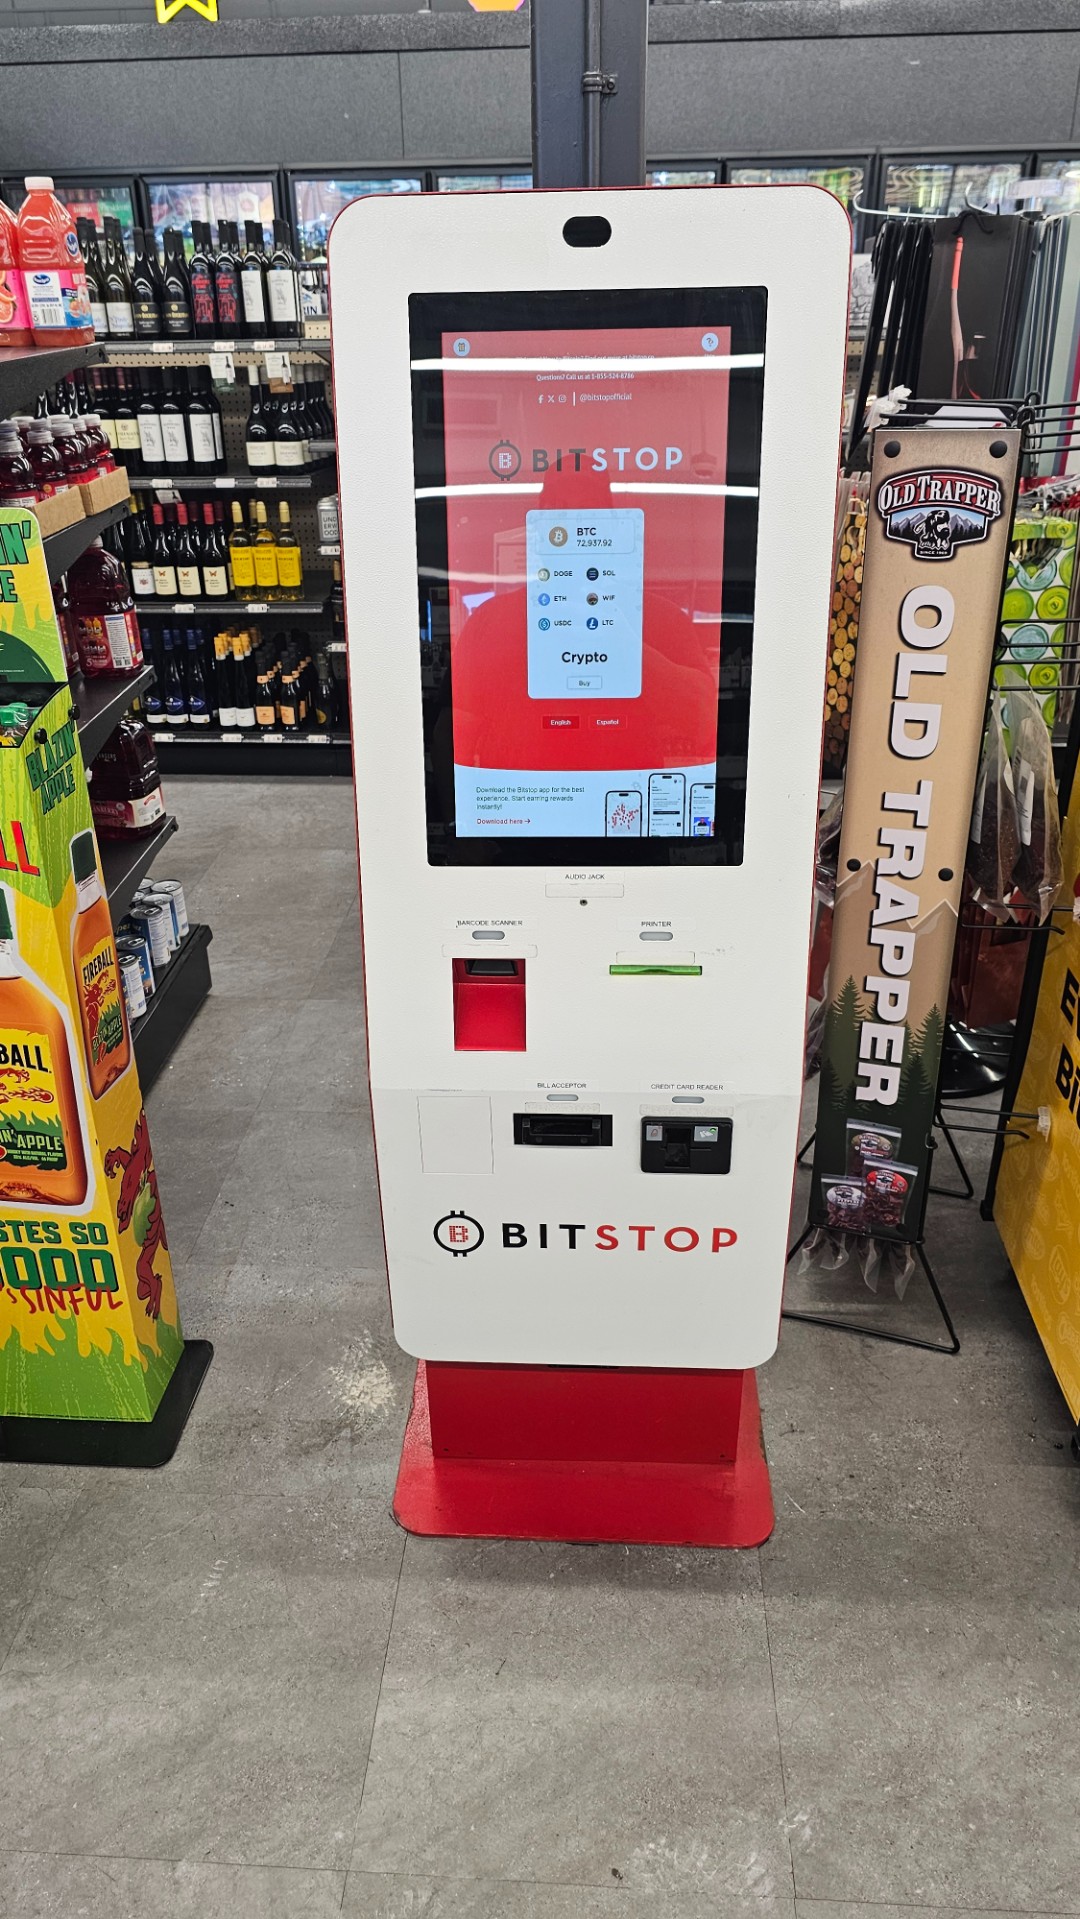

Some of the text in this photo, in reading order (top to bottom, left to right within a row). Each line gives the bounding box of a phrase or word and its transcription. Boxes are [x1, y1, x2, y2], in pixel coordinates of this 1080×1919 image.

[579, 393, 632, 402] @bitstopofficial
[532, 447, 683, 472] BITSTOP
[879, 475, 1000, 514] OLD TRAPPER
[576, 527, 597, 536] BTC
[576, 539, 613, 547] 72,937.92
[561, 651, 608, 665] Crypto
[550, 719, 571, 727] English
[596, 718, 619, 727] Español
[40, 763, 76, 816] APPLE
[517, 786, 537, 794] Bitstop
[855, 584, 955, 1107] OLD TRAPPER
[82, 946, 114, 985] FIREBALL
[651, 1083, 675, 1091] CREDIT
[676, 1083, 695, 1091] CARD
[17, 1134, 62, 1151] APPLE
[71, 1221, 109, 1245] SO
[502, 1222, 738, 1253] BITSTOP
[0, 1246, 119, 1293] OOD
[19, 1283, 124, 1316] SINFUL
